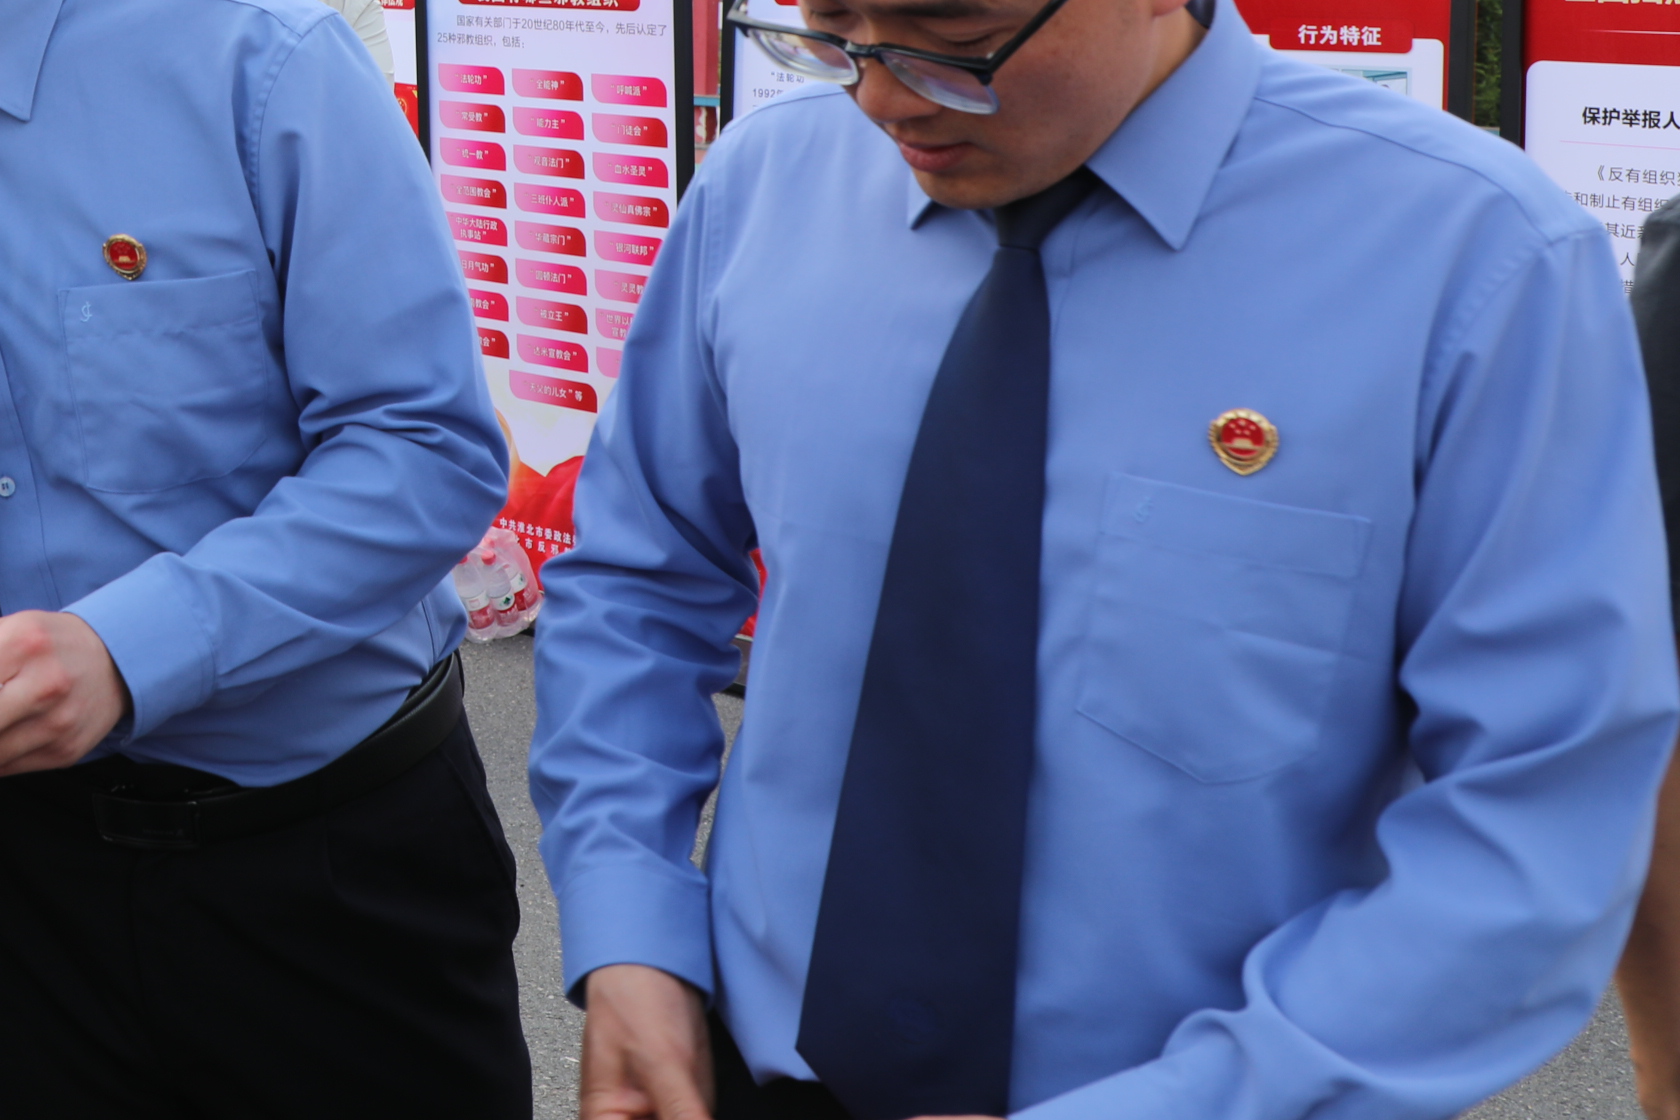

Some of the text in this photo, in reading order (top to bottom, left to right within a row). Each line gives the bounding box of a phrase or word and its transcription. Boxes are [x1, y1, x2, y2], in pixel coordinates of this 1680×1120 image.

[1298, 24, 1382, 46] 行为特征
[1582, 106, 1680, 130] 保护举报人
[1597, 165, 1680, 186] 《反有组织
[500, 517, 576, 547] 中共淮北市委政法
